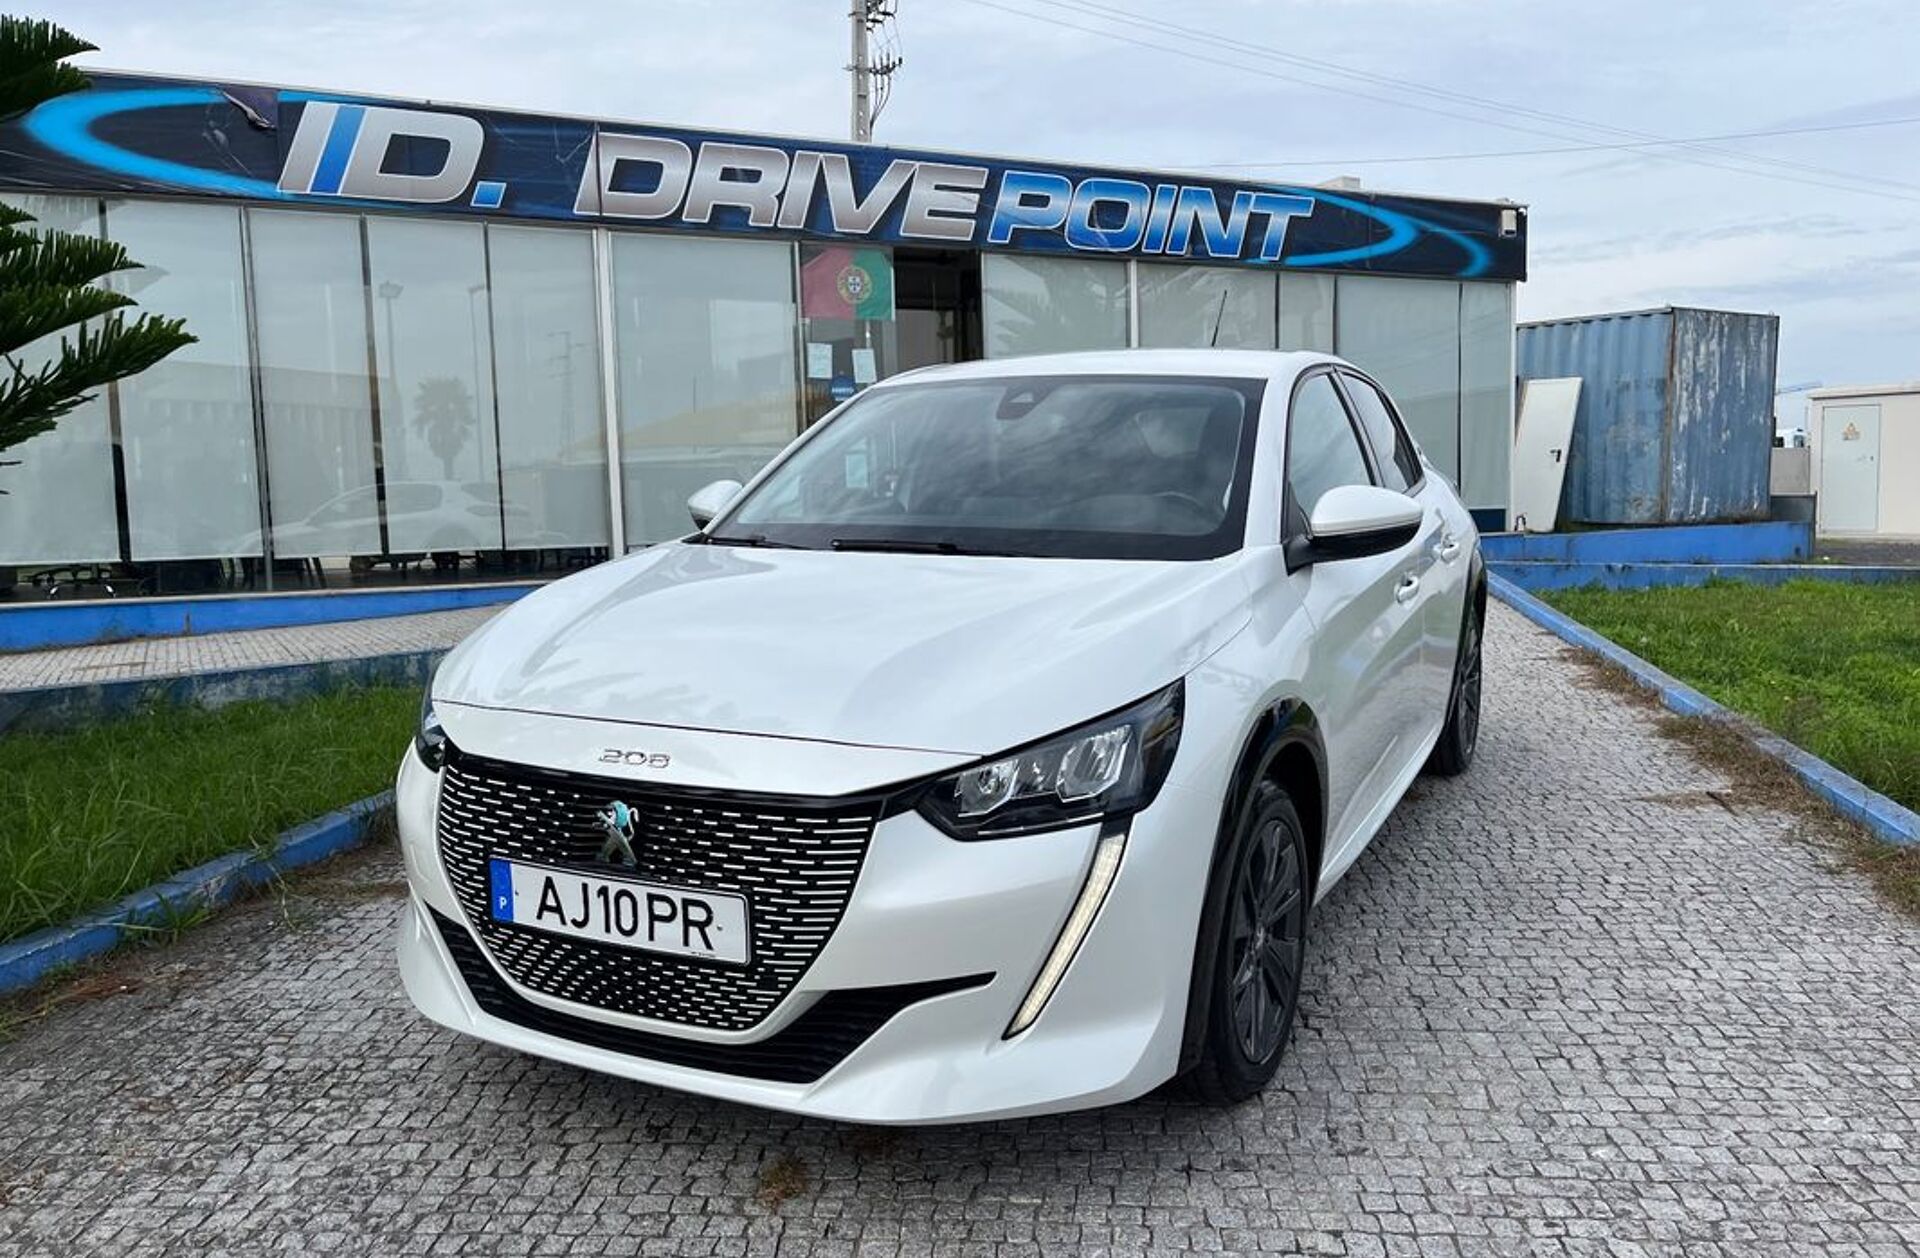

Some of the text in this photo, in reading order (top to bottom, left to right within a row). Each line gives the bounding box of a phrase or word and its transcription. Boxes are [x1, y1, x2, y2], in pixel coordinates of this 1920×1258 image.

[573, 131, 989, 241] DRIVE
[986, 170, 1314, 261] POINT
[599, 749, 671, 768] 208
[499, 876, 714, 951] P AJ10PR
